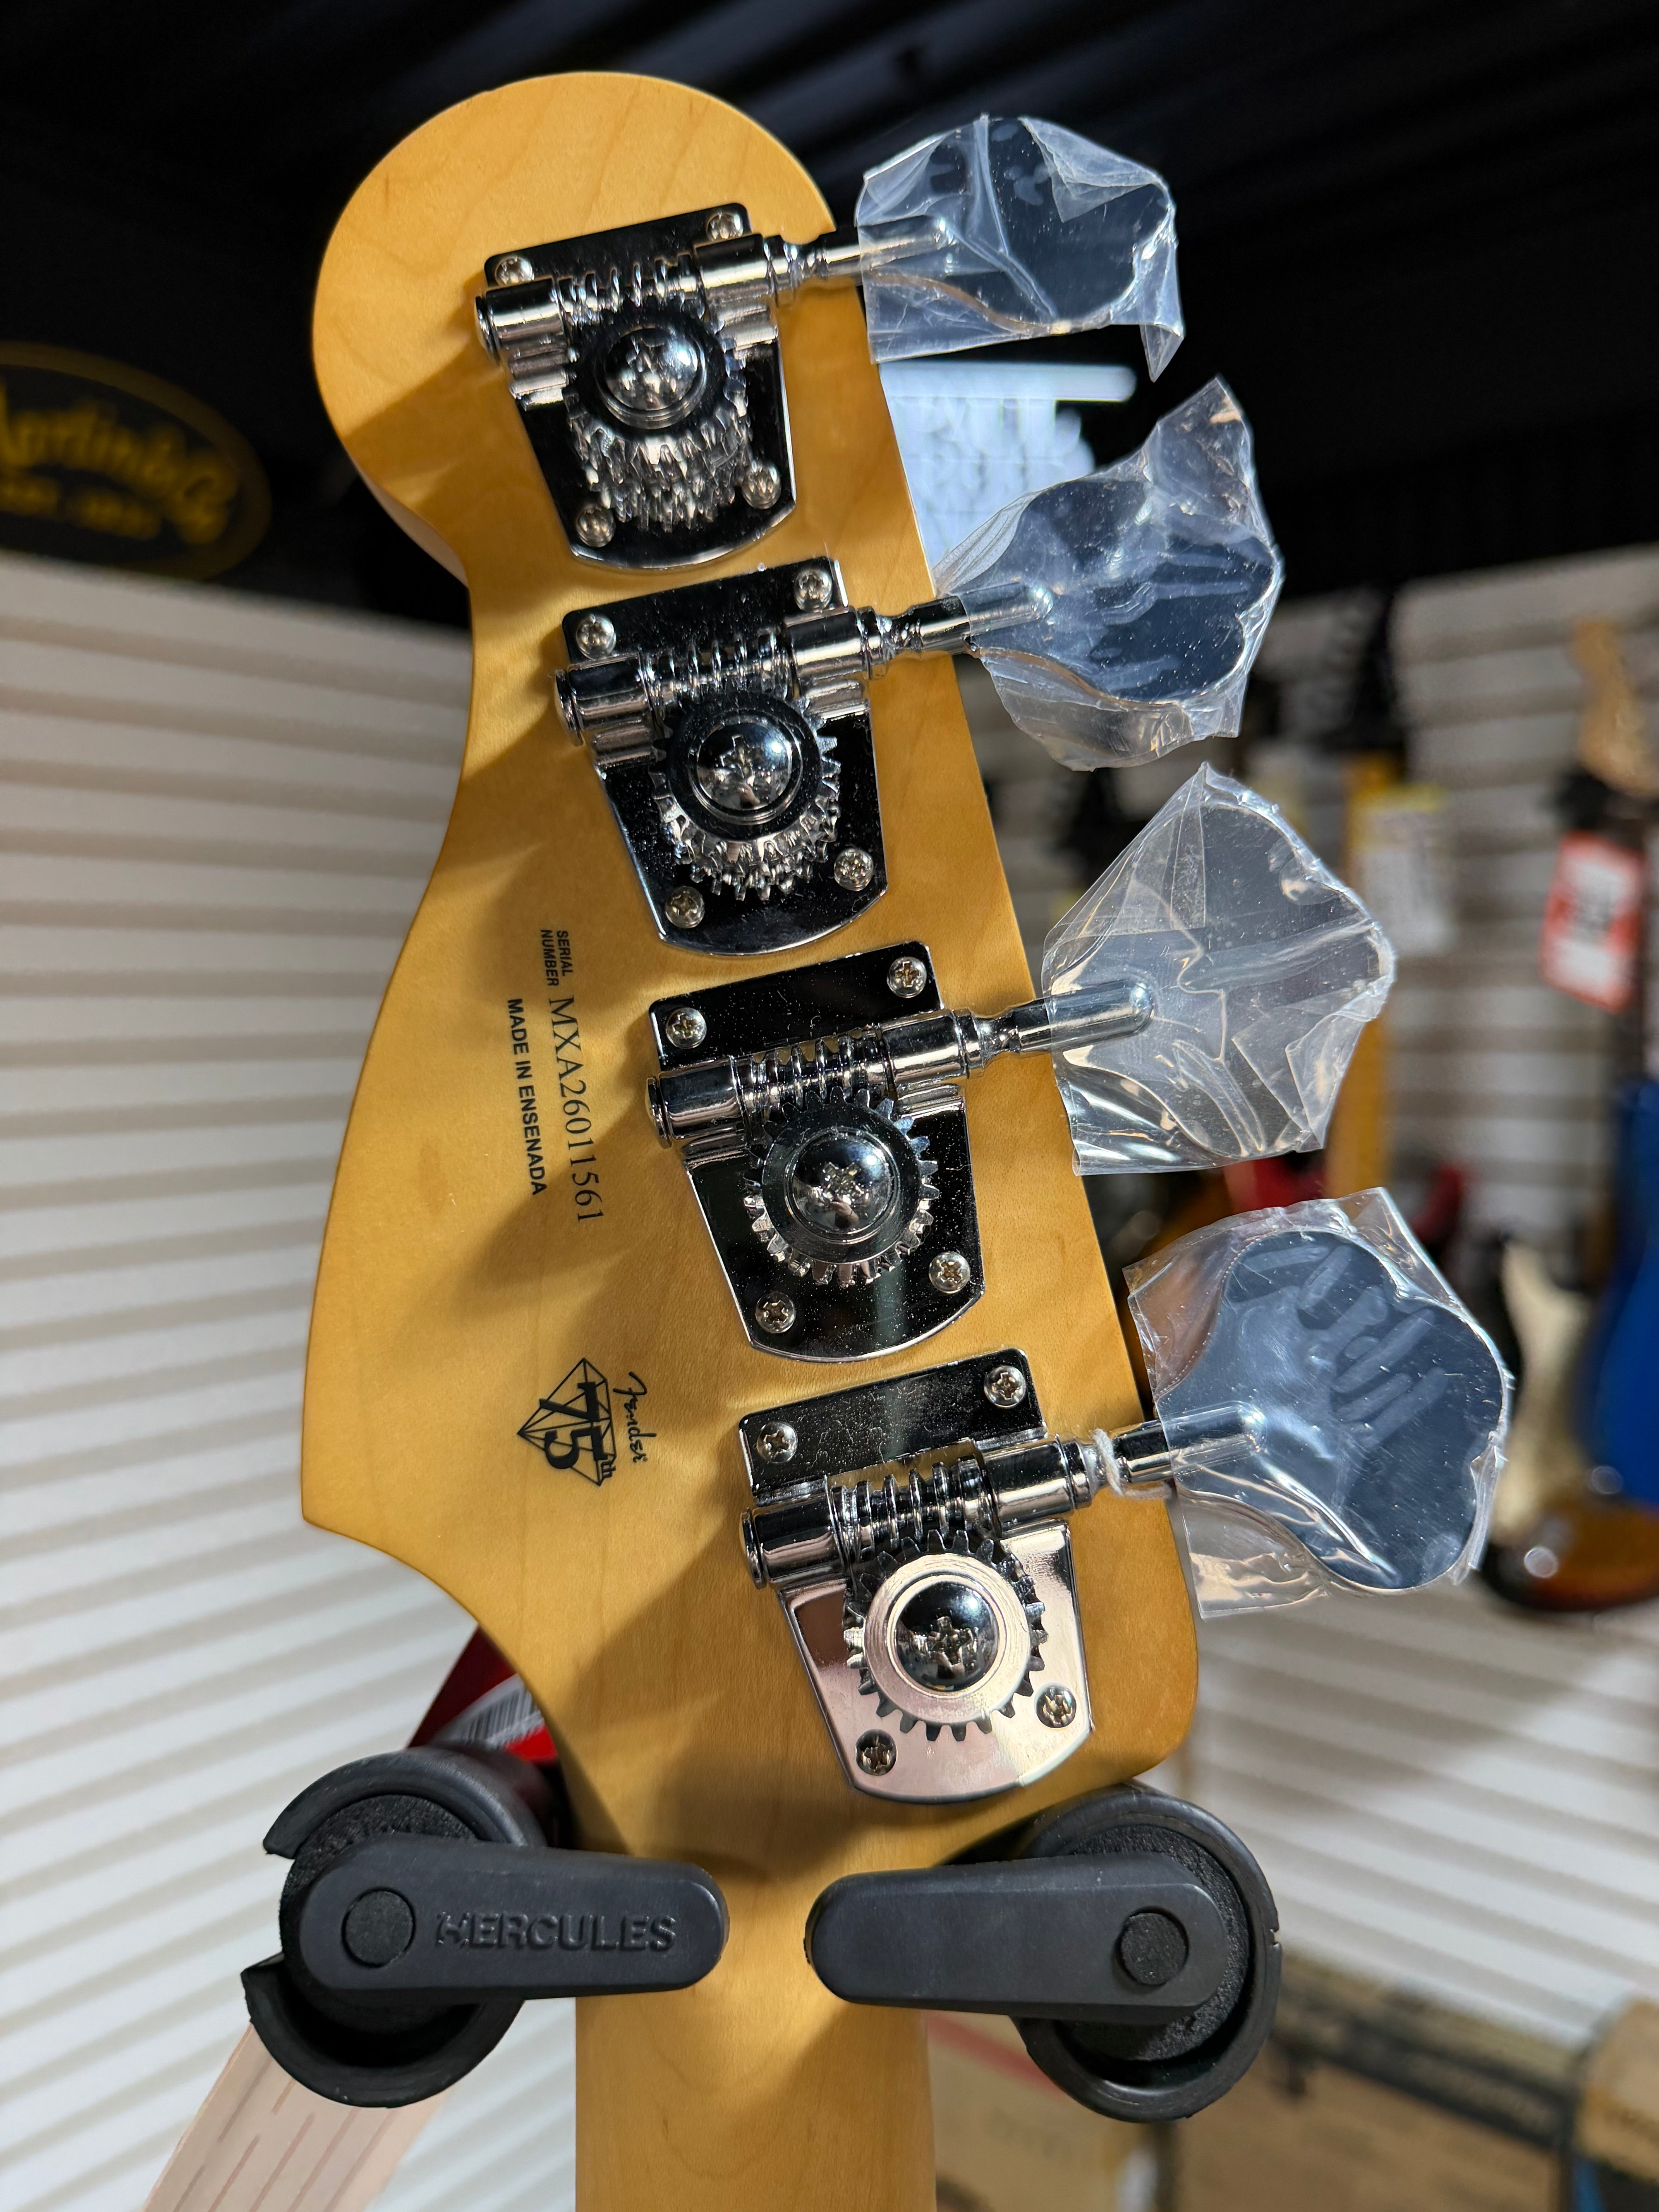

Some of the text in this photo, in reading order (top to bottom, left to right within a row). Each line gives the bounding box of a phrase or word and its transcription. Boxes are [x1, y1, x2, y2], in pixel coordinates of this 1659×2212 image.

[541, 929, 559, 986] NUMBER
[556, 930, 573, 976] SERIAL
[507, 998, 547, 1195] MADE IN ENSENADA
[549, 994, 604, 1222] MXA26011561
[613, 1371, 657, 1463] Fender
[434, 1911, 676, 1951] HERCULES
